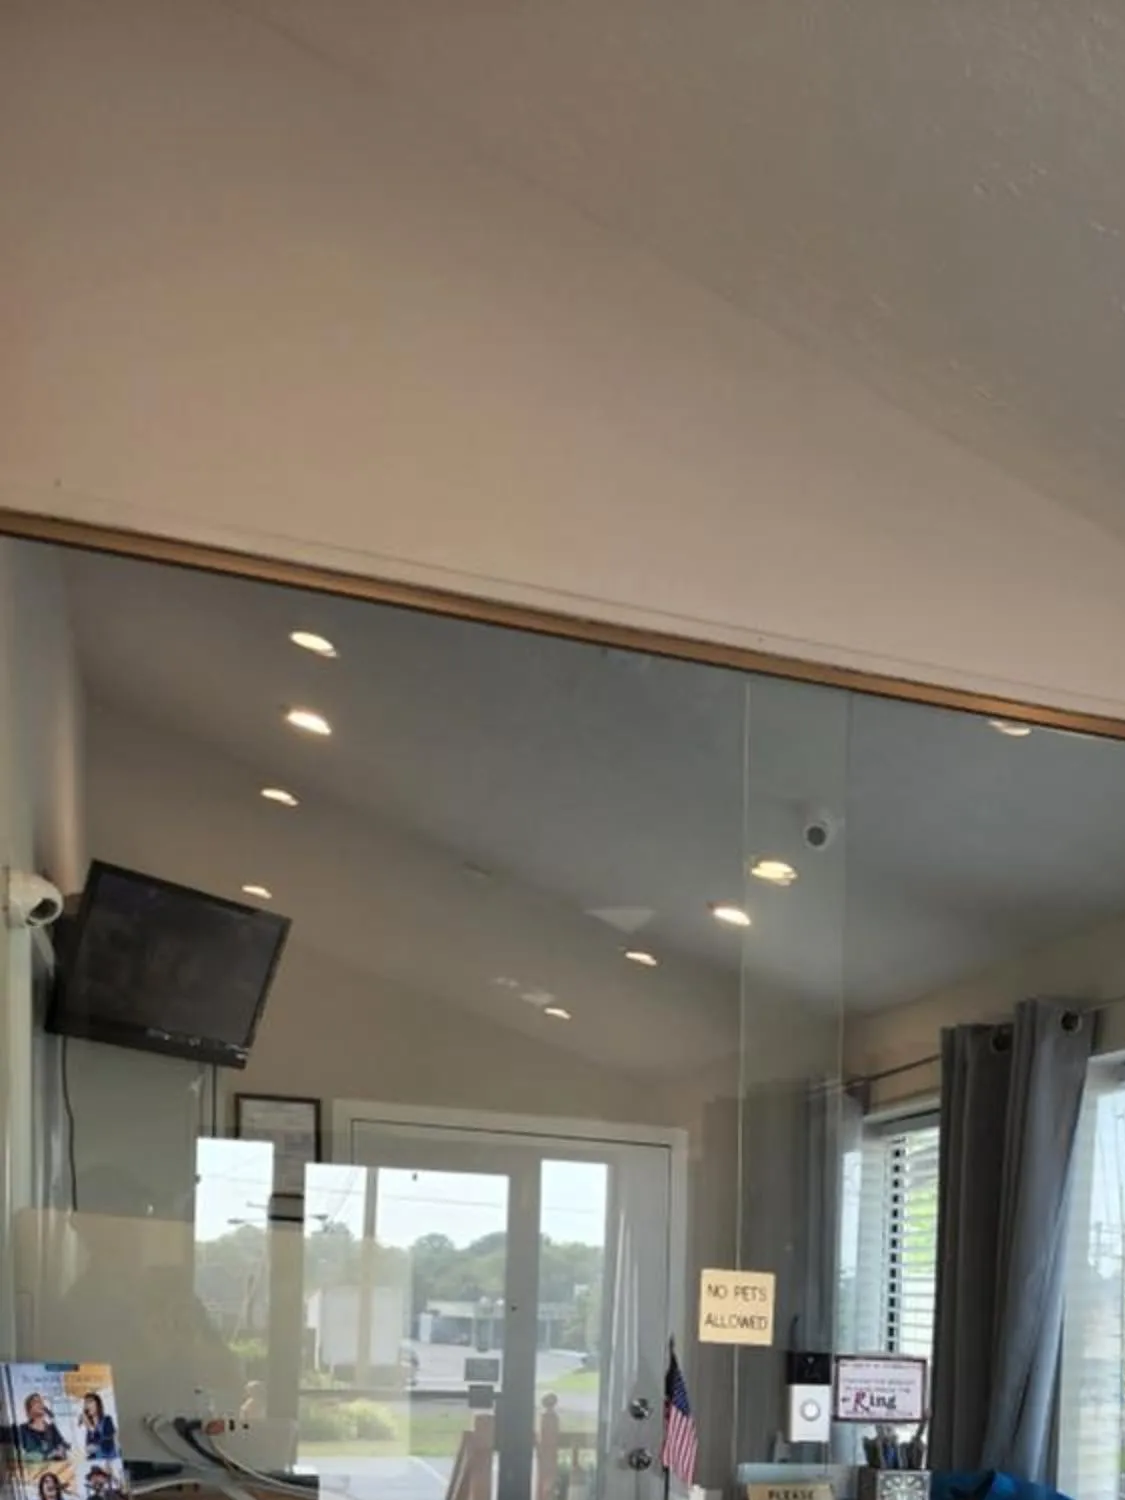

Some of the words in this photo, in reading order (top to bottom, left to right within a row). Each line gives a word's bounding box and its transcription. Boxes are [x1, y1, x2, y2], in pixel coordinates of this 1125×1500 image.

[707, 1283, 728, 1299] NO
[734, 1285, 767, 1302] PETS
[704, 1312, 768, 1331] ALLOWED
[851, 1390, 897, 1412] Ring
[768, 1489, 815, 1500] PLEASE
